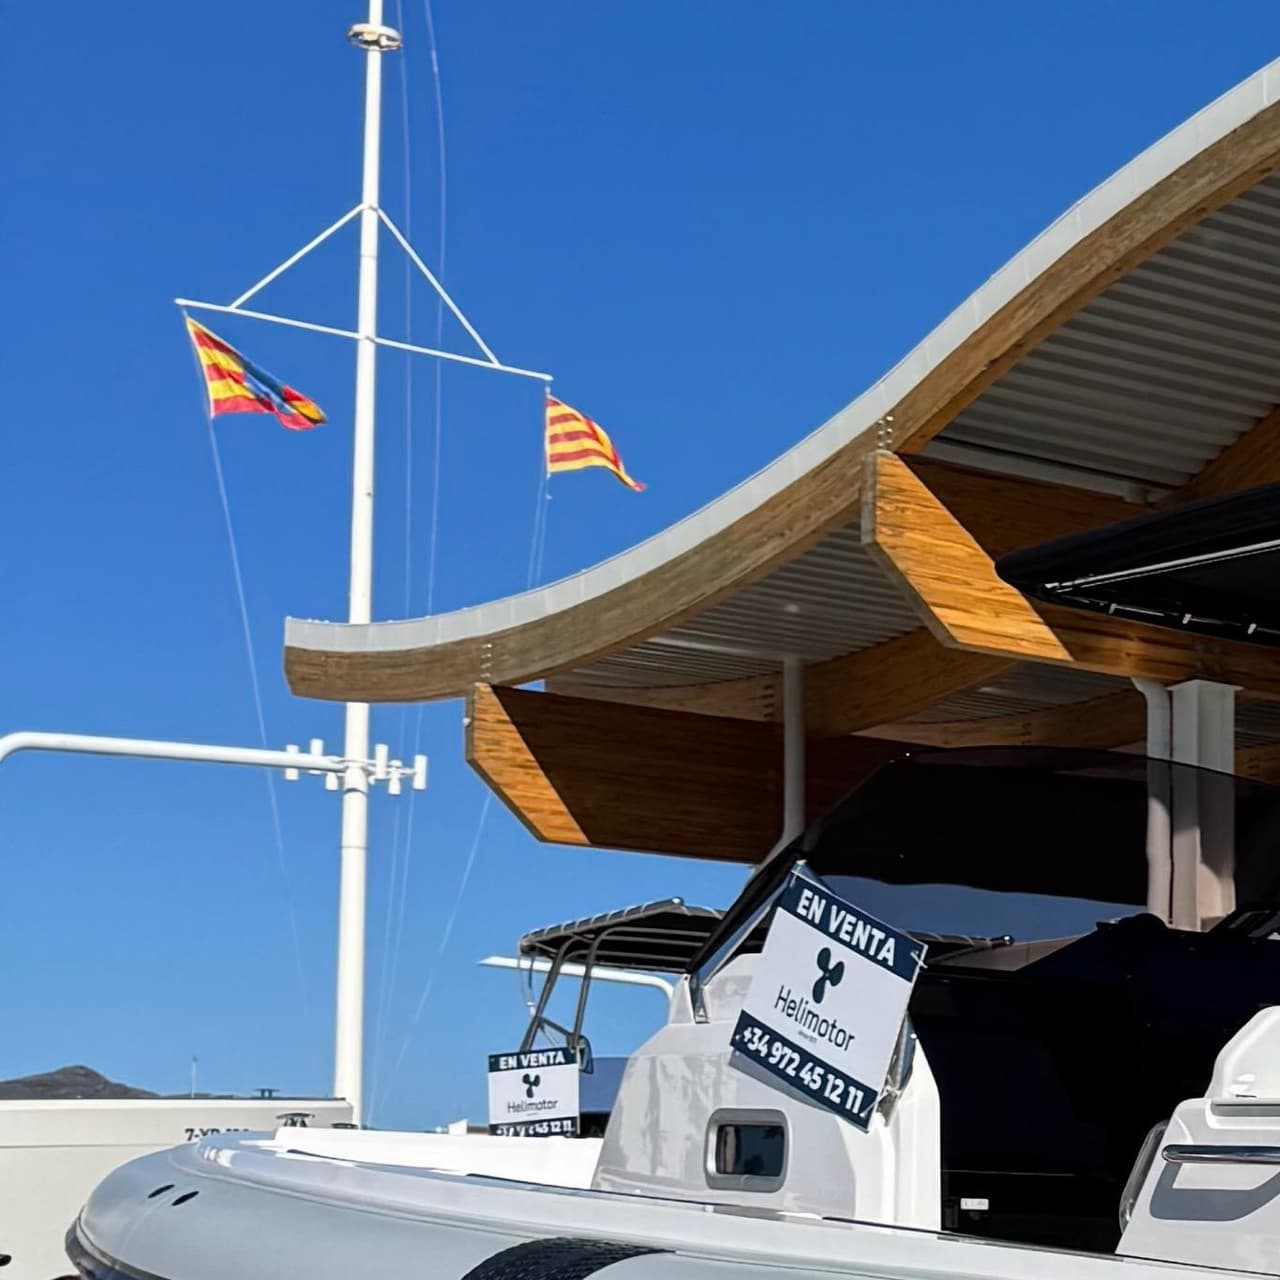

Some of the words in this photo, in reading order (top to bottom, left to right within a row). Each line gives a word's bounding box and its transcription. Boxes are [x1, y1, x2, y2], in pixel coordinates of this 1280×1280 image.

[796, 888, 827, 925] EN
[827, 904, 896, 967] VENTA
[774, 985, 855, 1052] Helimotor
[500, 1055, 517, 1070] EN
[519, 1051, 565, 1067] VENTA
[742, 1025, 770, 1059] +34
[768, 1041, 797, 1078] 972
[799, 1059, 823, 1092] 45
[824, 1072, 845, 1105] 12
[845, 1085, 866, 1115] 11
[507, 1099, 558, 1113] Helimotor
